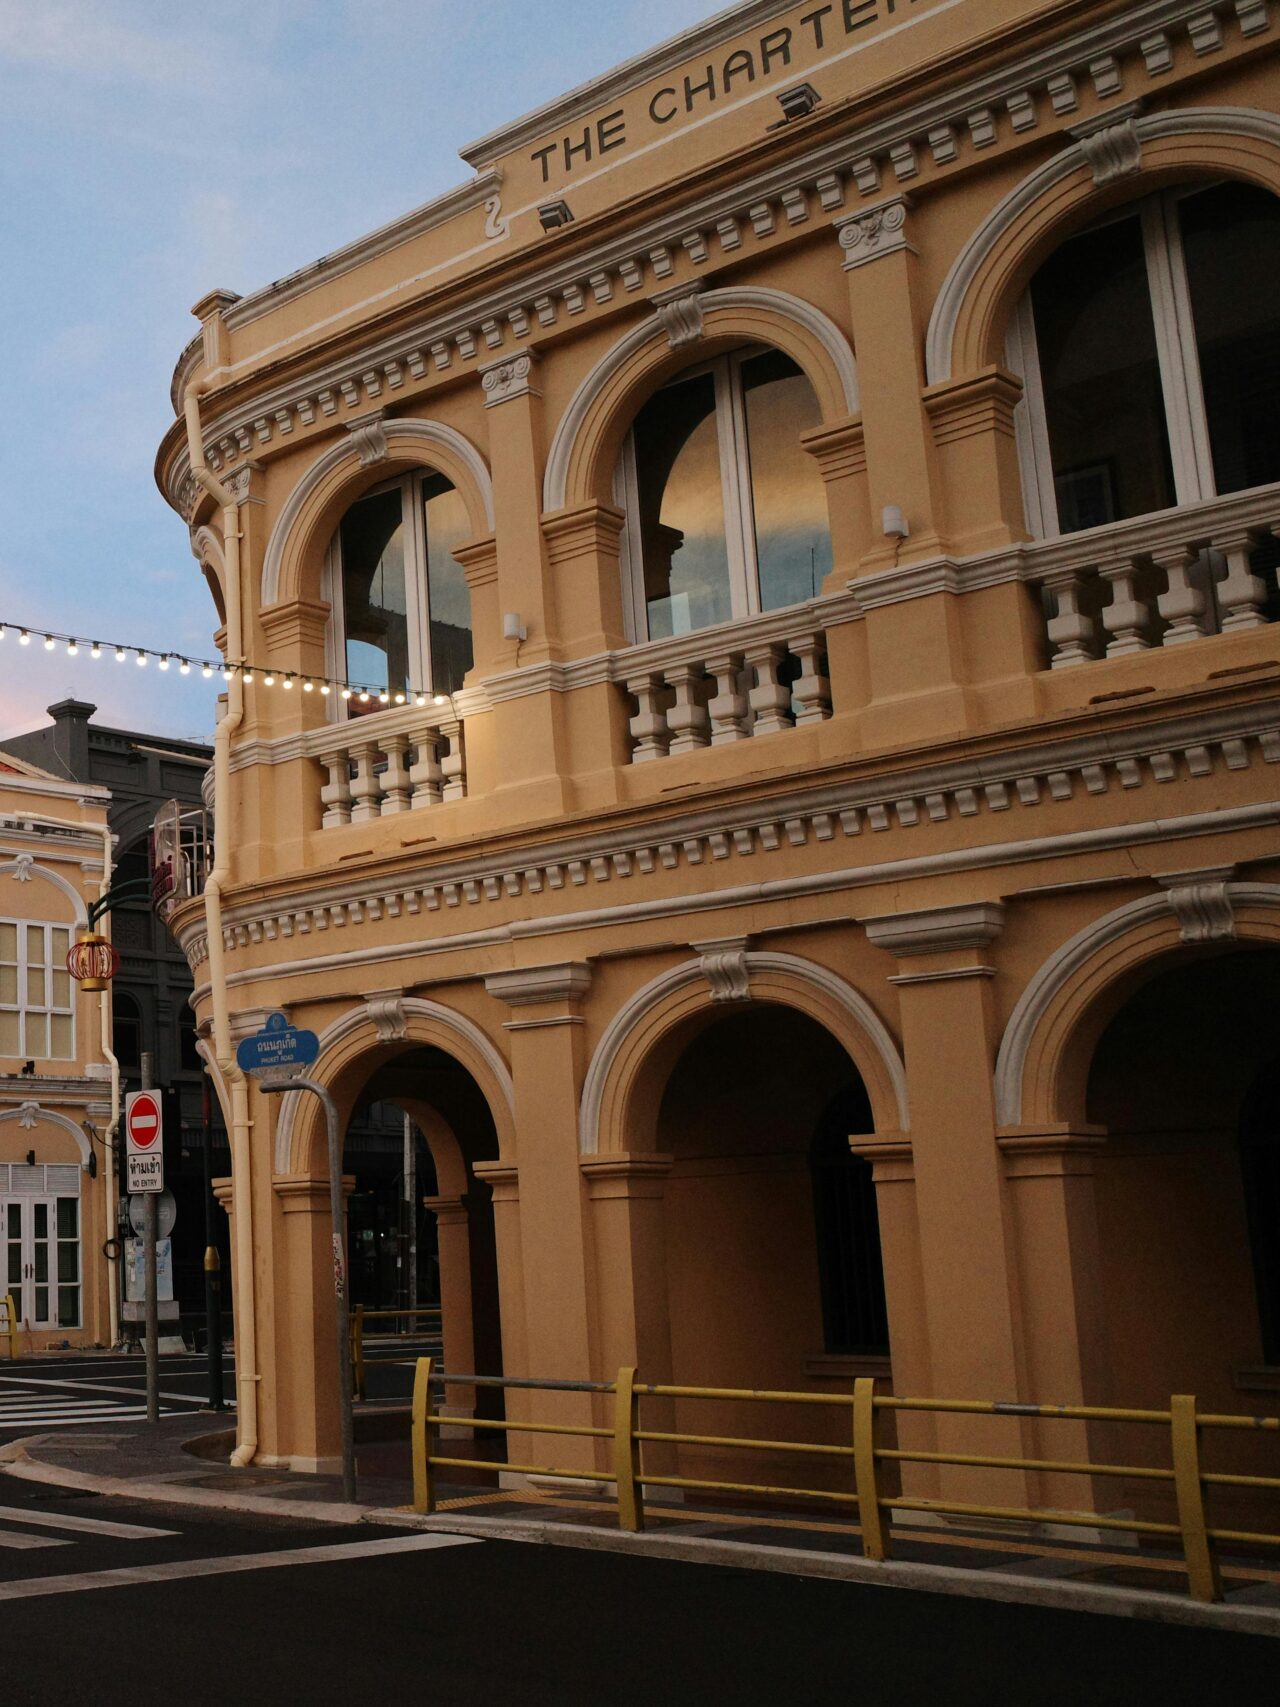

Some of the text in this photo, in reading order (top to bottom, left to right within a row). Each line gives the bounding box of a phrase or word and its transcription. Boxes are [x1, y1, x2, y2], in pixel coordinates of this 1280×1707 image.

[531, 108, 626, 182] THE
[130, 1156, 160, 1174] ห้ามเข้า
[141, 1179, 157, 1187] ENTRY
